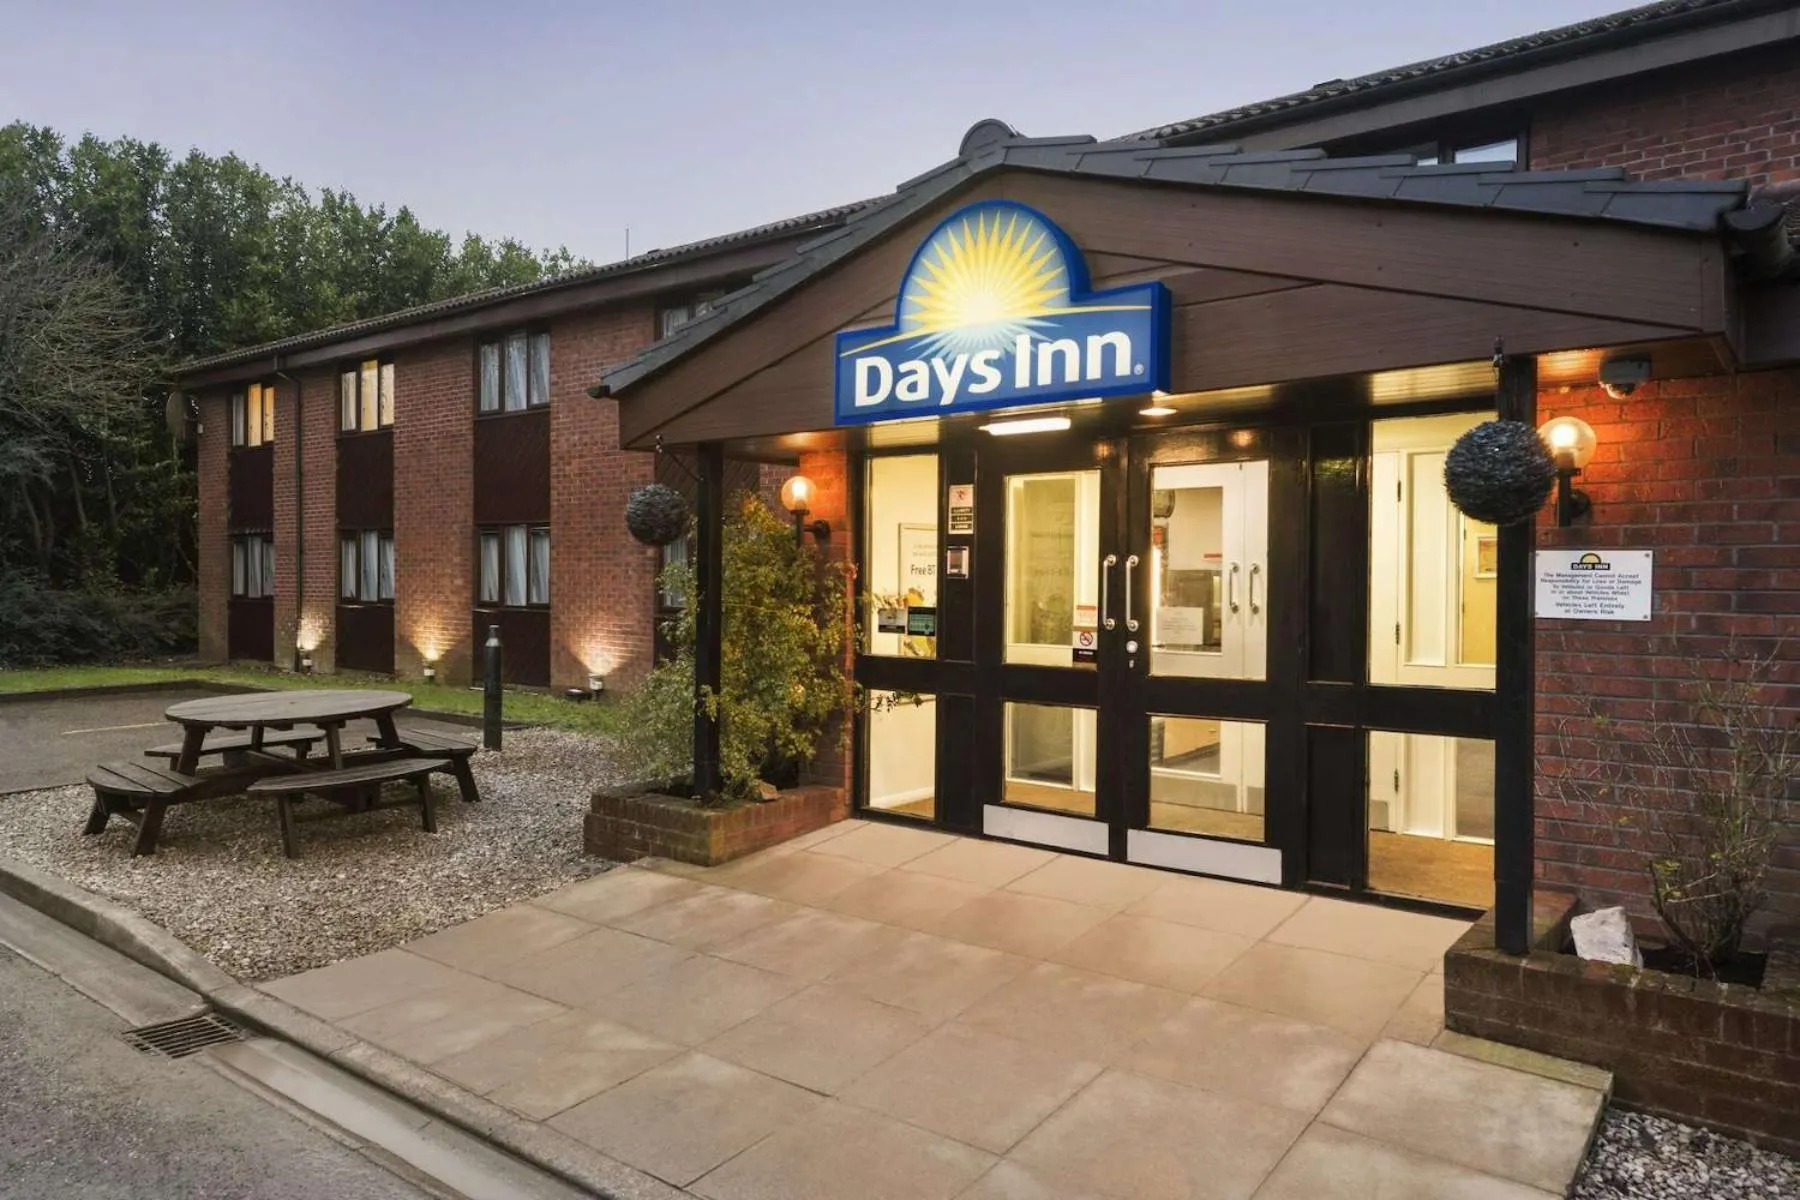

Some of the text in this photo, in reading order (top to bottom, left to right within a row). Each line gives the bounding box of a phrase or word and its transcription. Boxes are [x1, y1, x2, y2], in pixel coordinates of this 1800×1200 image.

[855, 331, 1131, 407] Days Inn
[911, 564, 926, 576] Free
